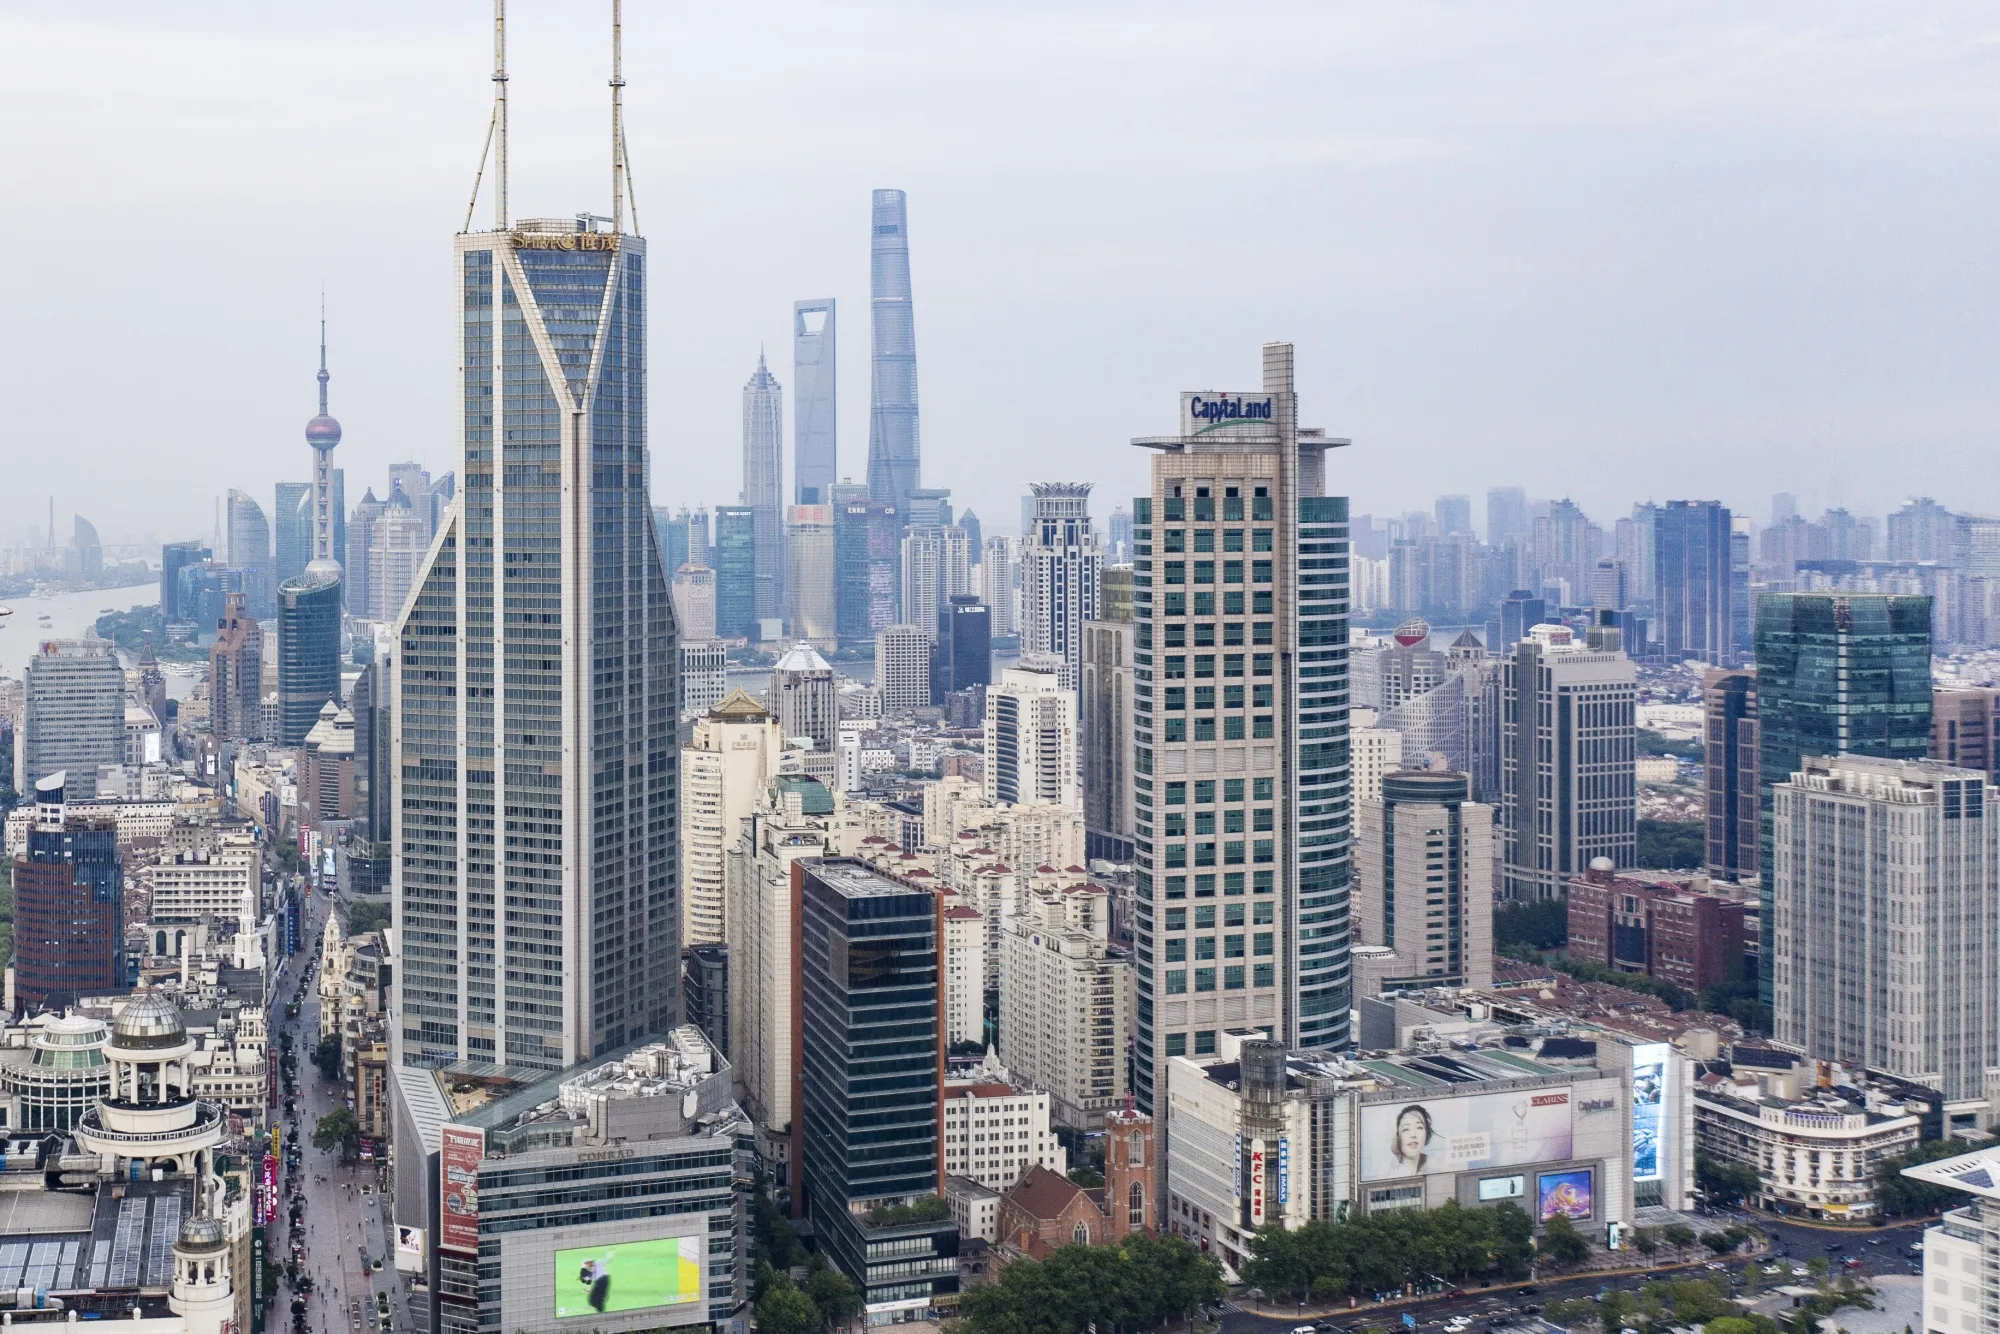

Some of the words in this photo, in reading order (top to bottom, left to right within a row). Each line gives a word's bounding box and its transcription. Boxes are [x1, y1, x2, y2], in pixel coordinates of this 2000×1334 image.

[580, 232, 618, 251] 世茂
[1191, 393, 1272, 423] CapitaLand
[1531, 1094, 1568, 1106] CLARINS
[1577, 1097, 1614, 1113] CapitaLand
[577, 1148, 635, 1162] CONRAD
[1251, 1151, 1264, 1184] KFC
